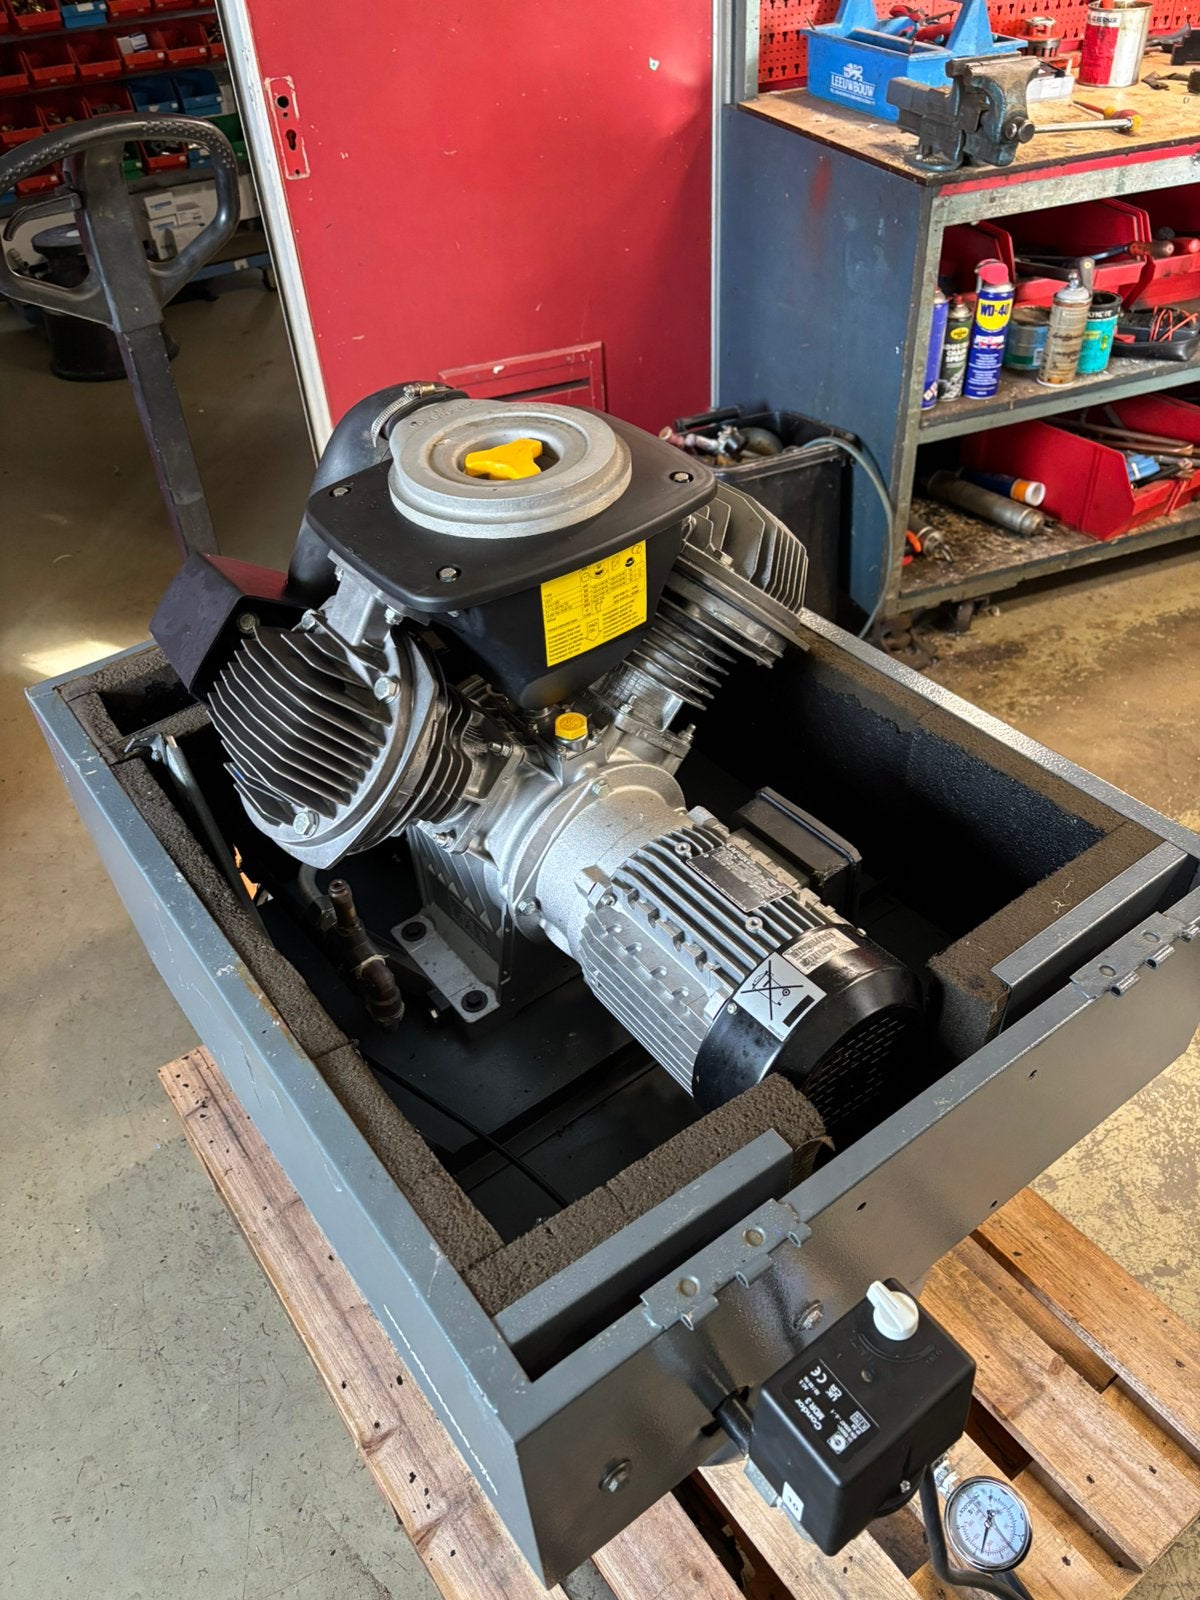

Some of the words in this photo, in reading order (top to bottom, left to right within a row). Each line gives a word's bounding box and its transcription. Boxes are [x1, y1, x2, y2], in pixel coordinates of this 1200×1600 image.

[831, 74, 875, 97] LEEUWBOUW
[980, 303, 1010, 317] WD-40
[794, 1398, 822, 1431] Condor
[809, 1402, 825, 1421] MDR
